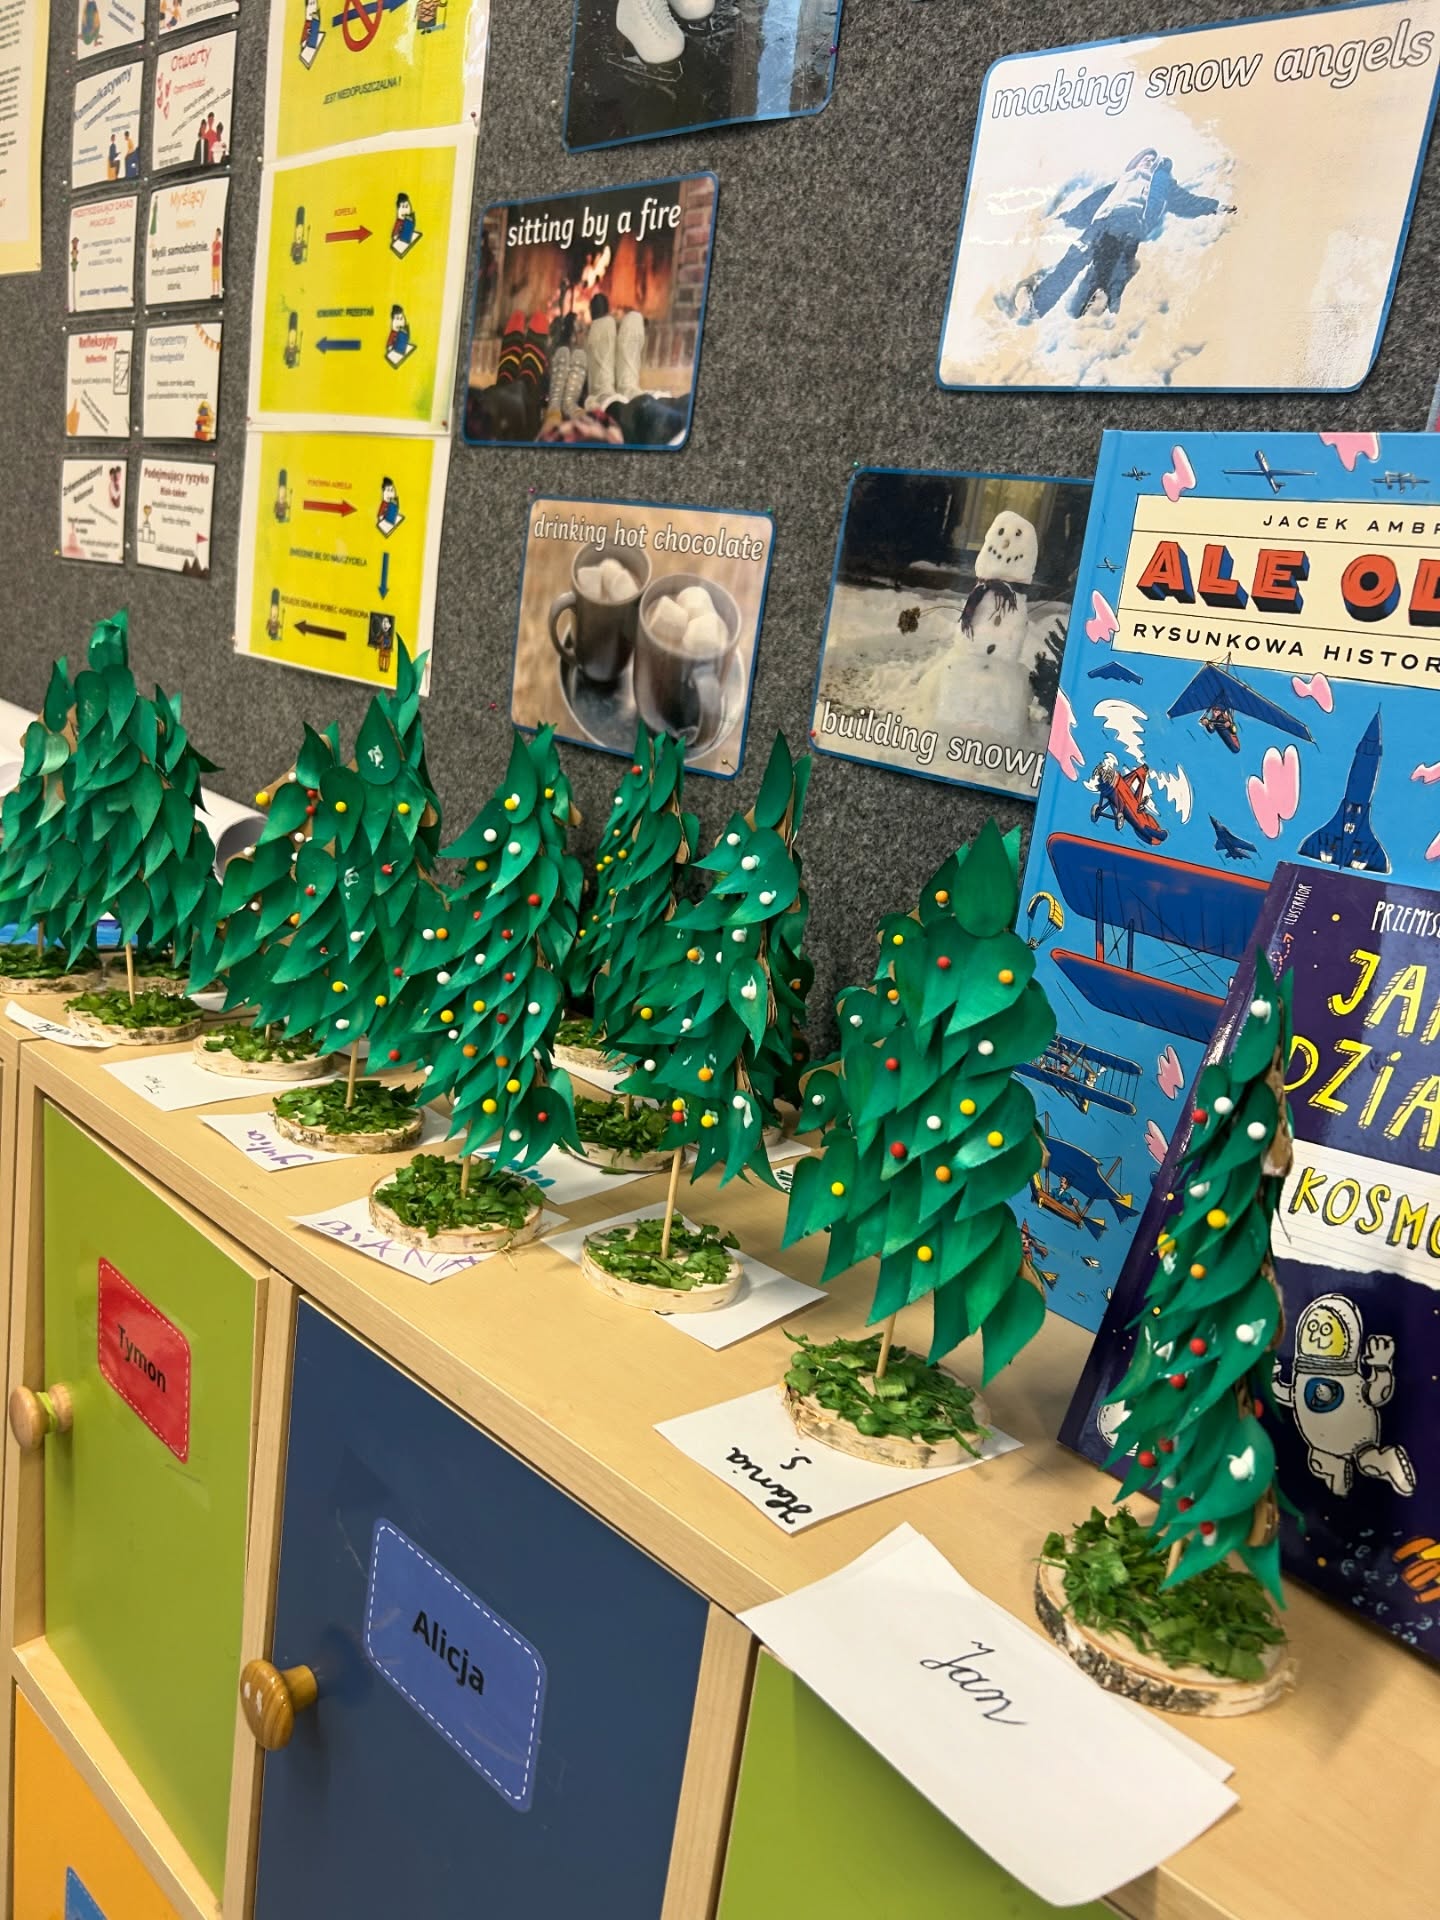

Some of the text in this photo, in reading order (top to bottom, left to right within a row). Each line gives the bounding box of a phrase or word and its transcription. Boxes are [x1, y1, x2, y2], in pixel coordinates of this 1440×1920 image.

[992, 18, 1436, 118] making snow angels
[507, 198, 682, 249] sitting by a fire
[534, 512, 764, 561] drinking hot chocolate
[1263, 515, 1348, 531] JACEK
[1137, 541, 1310, 614] ALE
[1133, 623, 1440, 675] RYSUNKOWA HISTOR
[821, 701, 938, 765] building
[118, 1323, 166, 1393] Tymon
[726, 1446, 813, 1524] Hania
[412, 1610, 486, 1696] Alicja
[920, 1640, 1028, 1726] Jan
